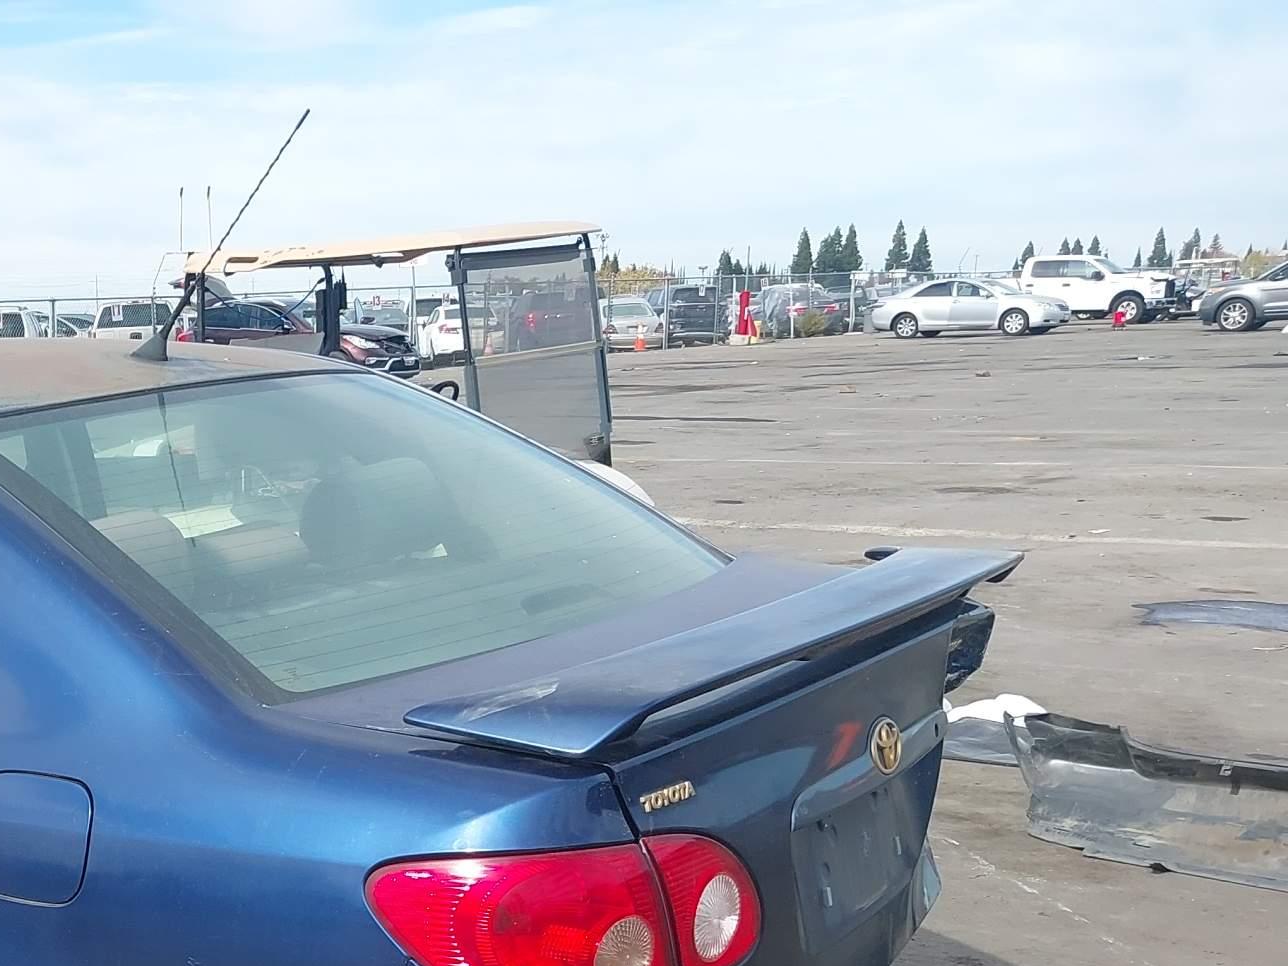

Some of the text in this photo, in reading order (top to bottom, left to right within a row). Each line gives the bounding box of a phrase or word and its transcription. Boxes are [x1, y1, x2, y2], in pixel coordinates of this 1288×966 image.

[372, 295, 381, 307] 13
[442, 293, 450, 304] 14
[112, 303, 121, 316] 11
[639, 780, 697, 813] TOYOTA
